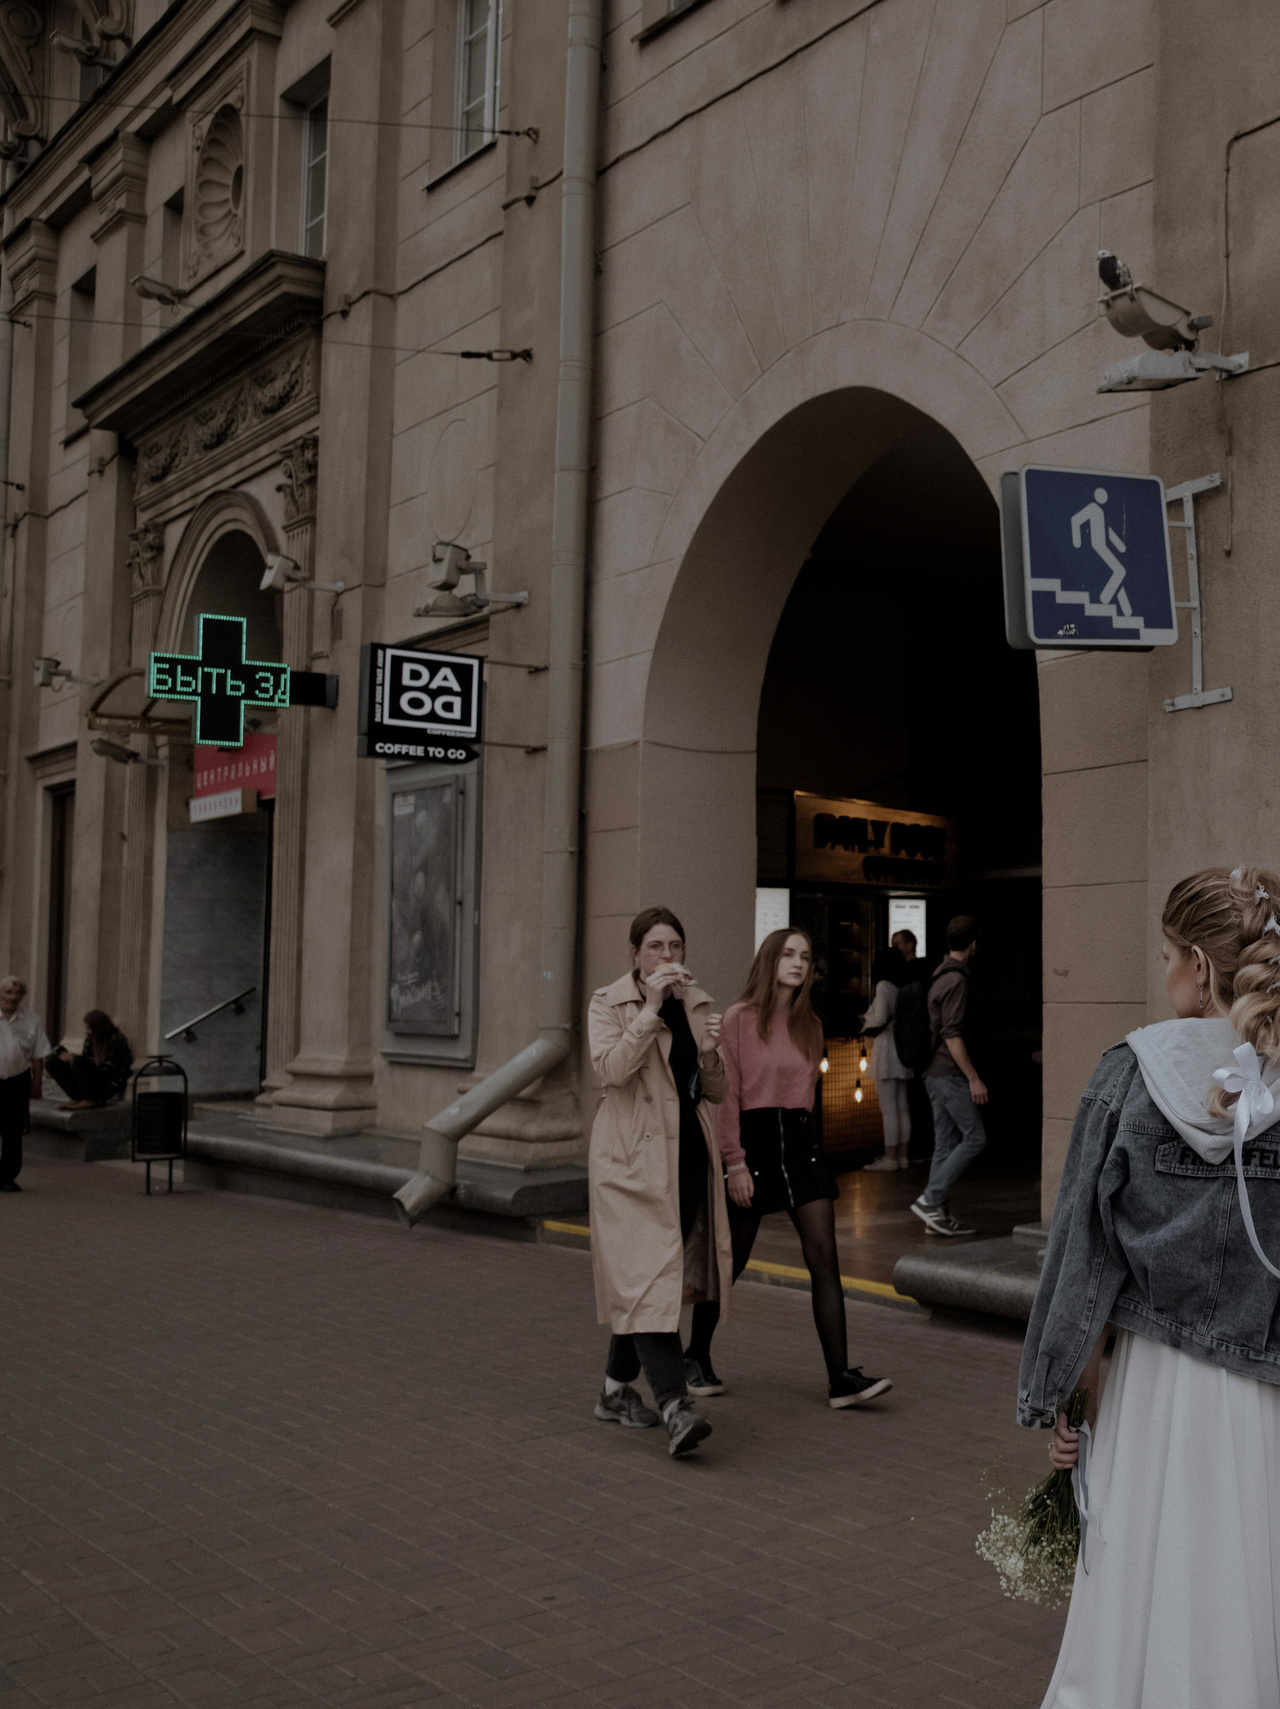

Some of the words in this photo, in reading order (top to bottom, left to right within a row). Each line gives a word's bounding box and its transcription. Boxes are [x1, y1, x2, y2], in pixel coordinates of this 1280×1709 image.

[153, 662, 246, 697] БЫТЬ
[401, 661, 462, 692] DA
[374, 742, 425, 757] COFFEE
[427, 746, 445, 758] TO
[446, 748, 467, 760] GO
